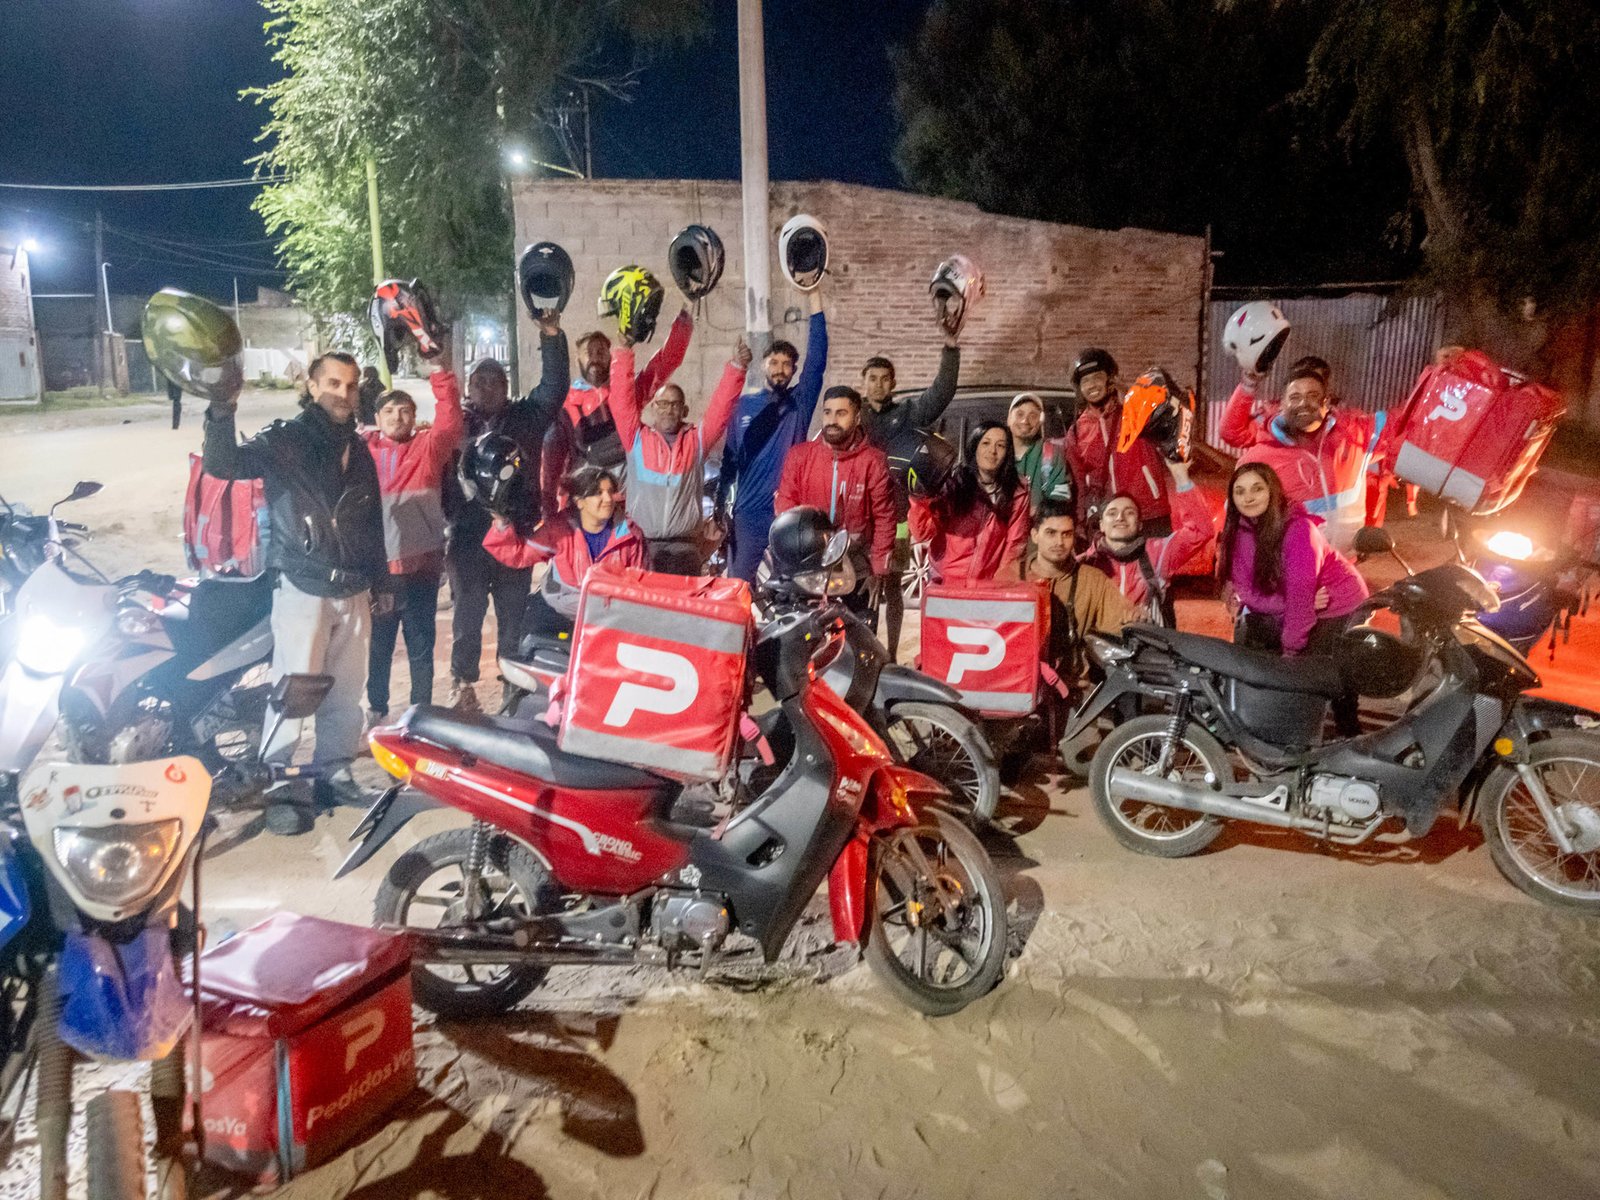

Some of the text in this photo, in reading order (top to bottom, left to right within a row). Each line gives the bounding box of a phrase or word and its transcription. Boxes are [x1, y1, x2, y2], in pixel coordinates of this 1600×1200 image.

[1428, 391, 1468, 422] P
[603, 642, 699, 728] P
[946, 626, 1007, 685] P
[341, 1008, 386, 1075] P
[203, 1116, 248, 1137] osYa
